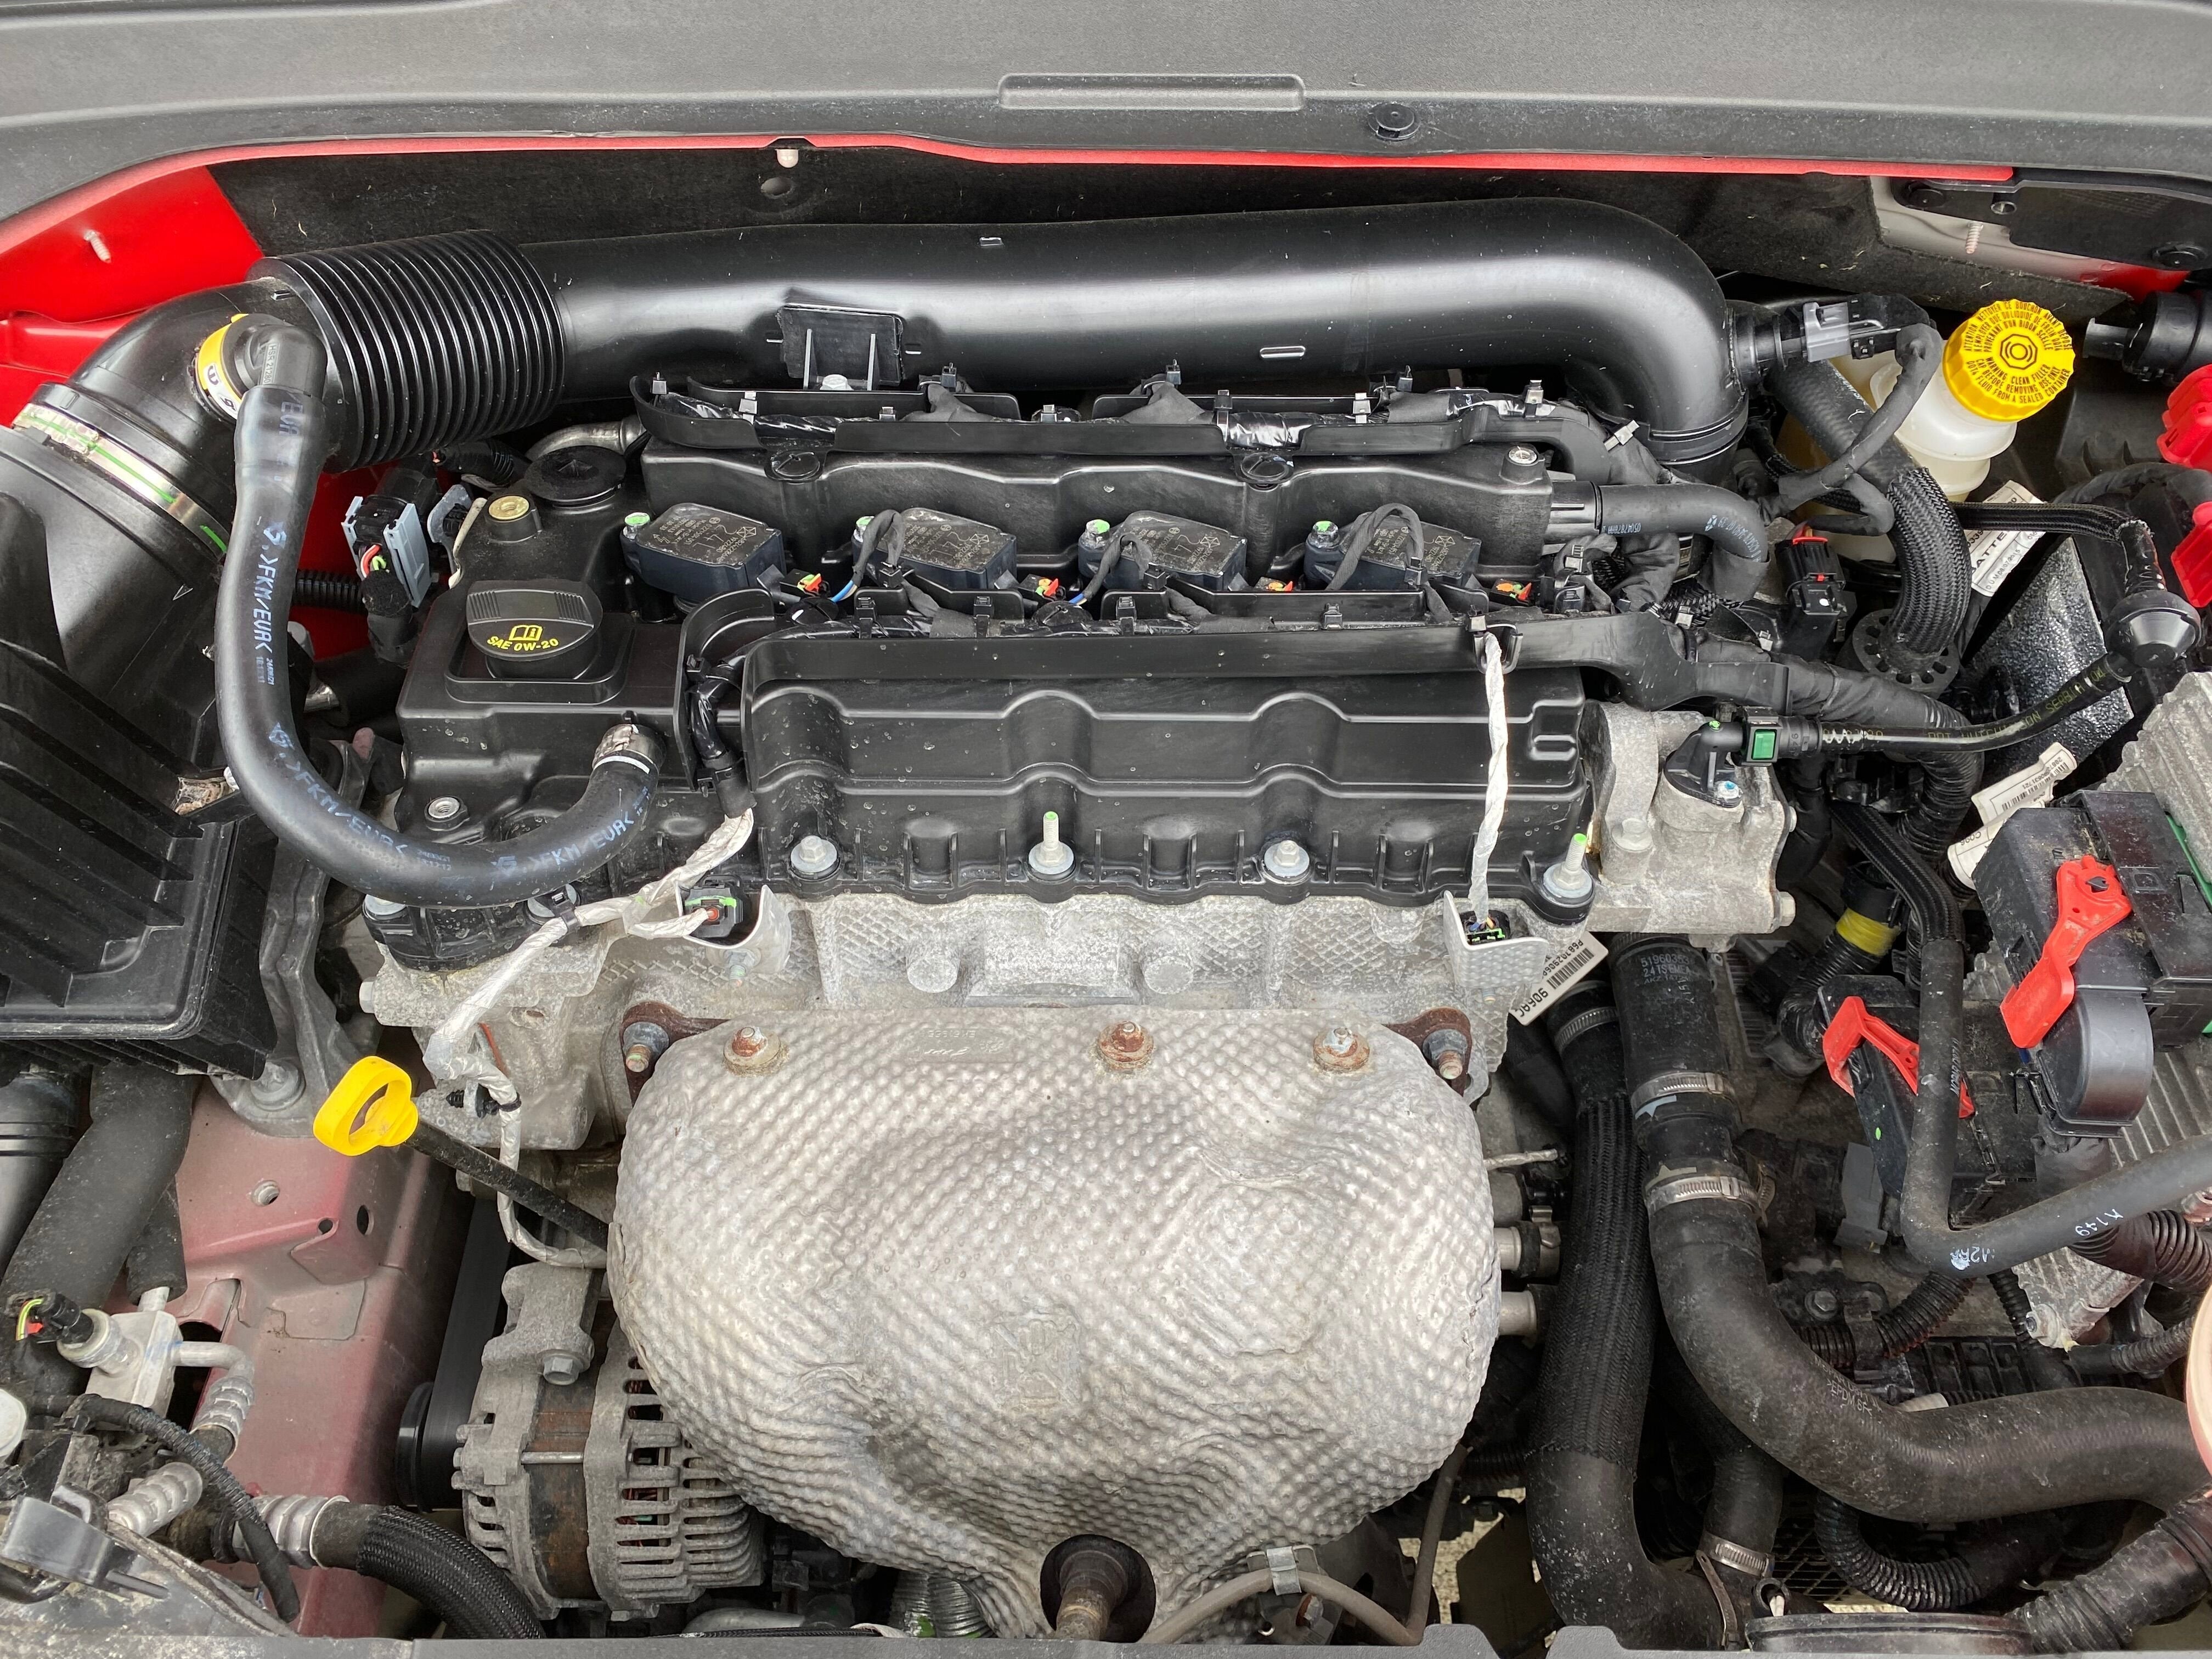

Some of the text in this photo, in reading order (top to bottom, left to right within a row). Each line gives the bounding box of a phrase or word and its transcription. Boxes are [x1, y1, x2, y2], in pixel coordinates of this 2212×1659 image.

[1964, 324, 1977, 351] ATTENTION
[1978, 304, 2002, 321] NETTOYER
[2016, 302, 2042, 314] BOUCHON
[2043, 312, 2061, 328] AVANT
[2058, 329, 2072, 350] DEPOSE
[1984, 324, 2002, 352] PROVENANT
[2019, 320, 2037, 331] BIDON
[2037, 330, 2053, 351] SCELLE
[1989, 314, 2002, 323] QUE
[2041, 321, 2057, 338] FREIN
[263, 343, 277, 383] HSR 21280
[1976, 359, 1986, 369] CAP
[1983, 368, 2004, 388] BEFORE
[2039, 379, 2051, 389] USE
[2049, 366, 2062, 380] ONLY
[2011, 376, 2030, 385] CLEAN
[2032, 364, 2051, 382] FILLER
[1966, 361, 1979, 375] DOT4
[1976, 375, 1991, 392] FLUID
[1993, 388, 2011, 401] FROM
[2019, 393, 2044, 404] SEALED
[2045, 368, 2071, 397] CONTAINER
[487, 636, 559, 652] SAE 0W-20
[2045, 681, 2085, 714] SERBIA
[1641, 953, 1690, 967] 51960353
